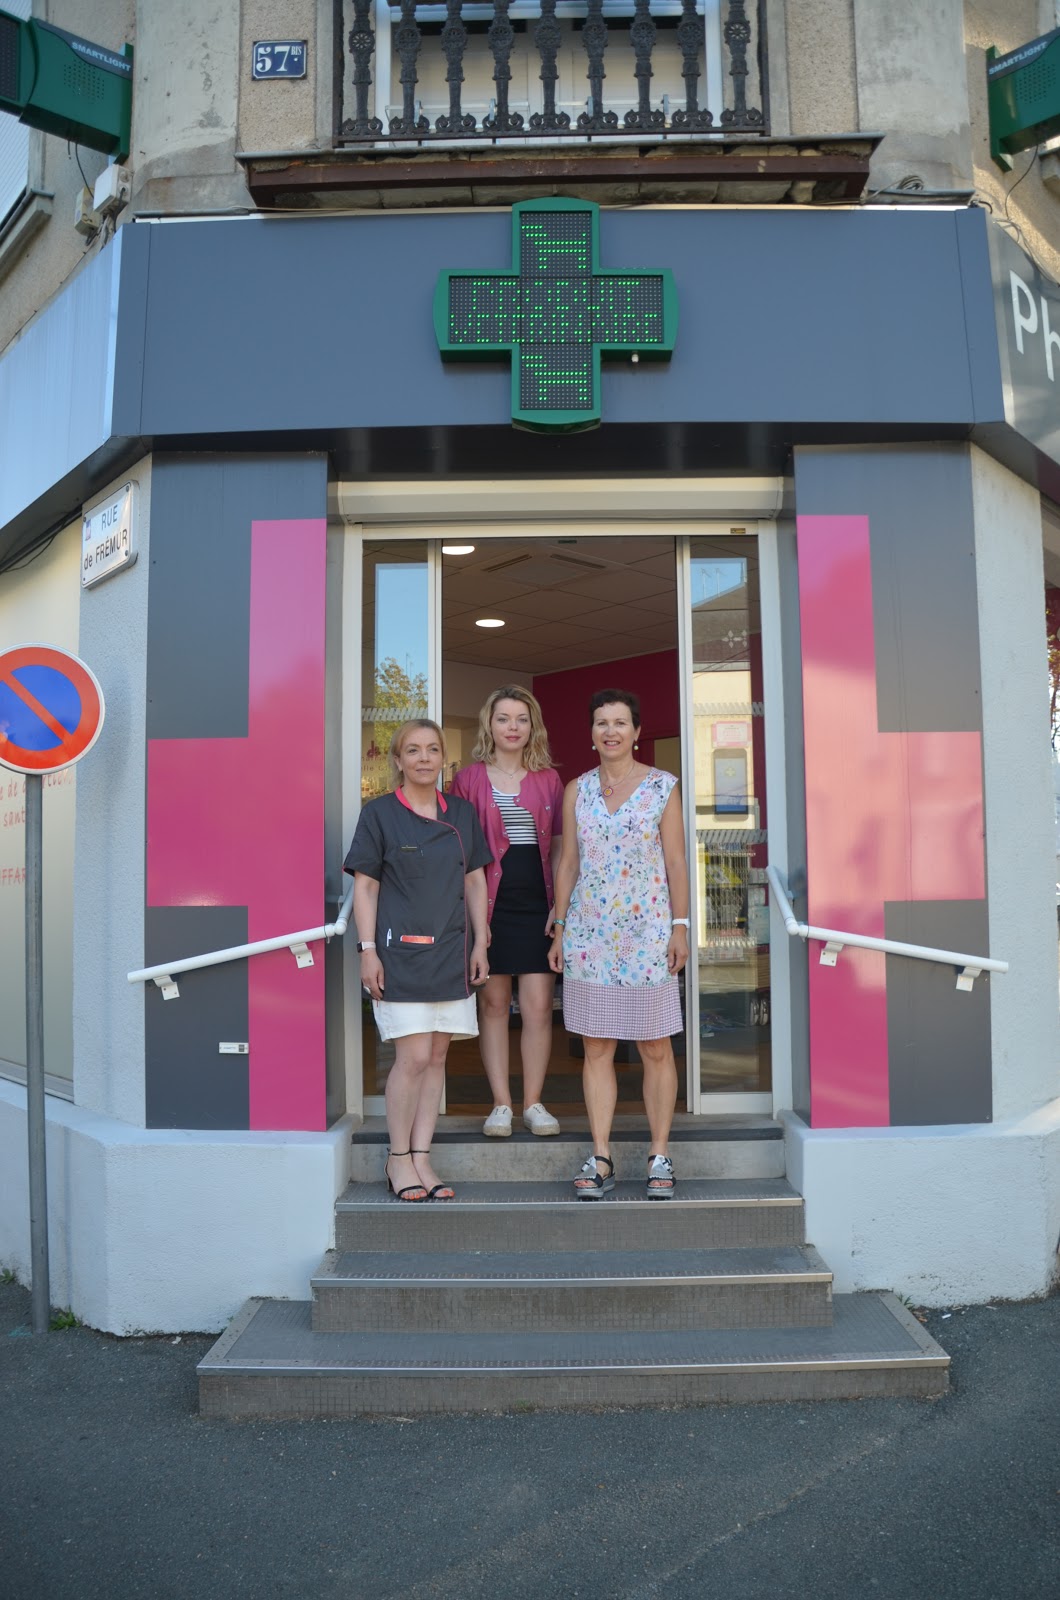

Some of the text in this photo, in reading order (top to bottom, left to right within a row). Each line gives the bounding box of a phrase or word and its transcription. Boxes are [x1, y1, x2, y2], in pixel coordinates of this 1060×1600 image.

[72, 41, 131, 72] SMARTLIGHT
[256, 45, 290, 73] 57
[989, 41, 1048, 75] SMARTLIGHT
[101, 504, 118, 531] RUE
[83, 528, 128, 570] de FRÉMUR
[3, 806, 26, 828] sant
